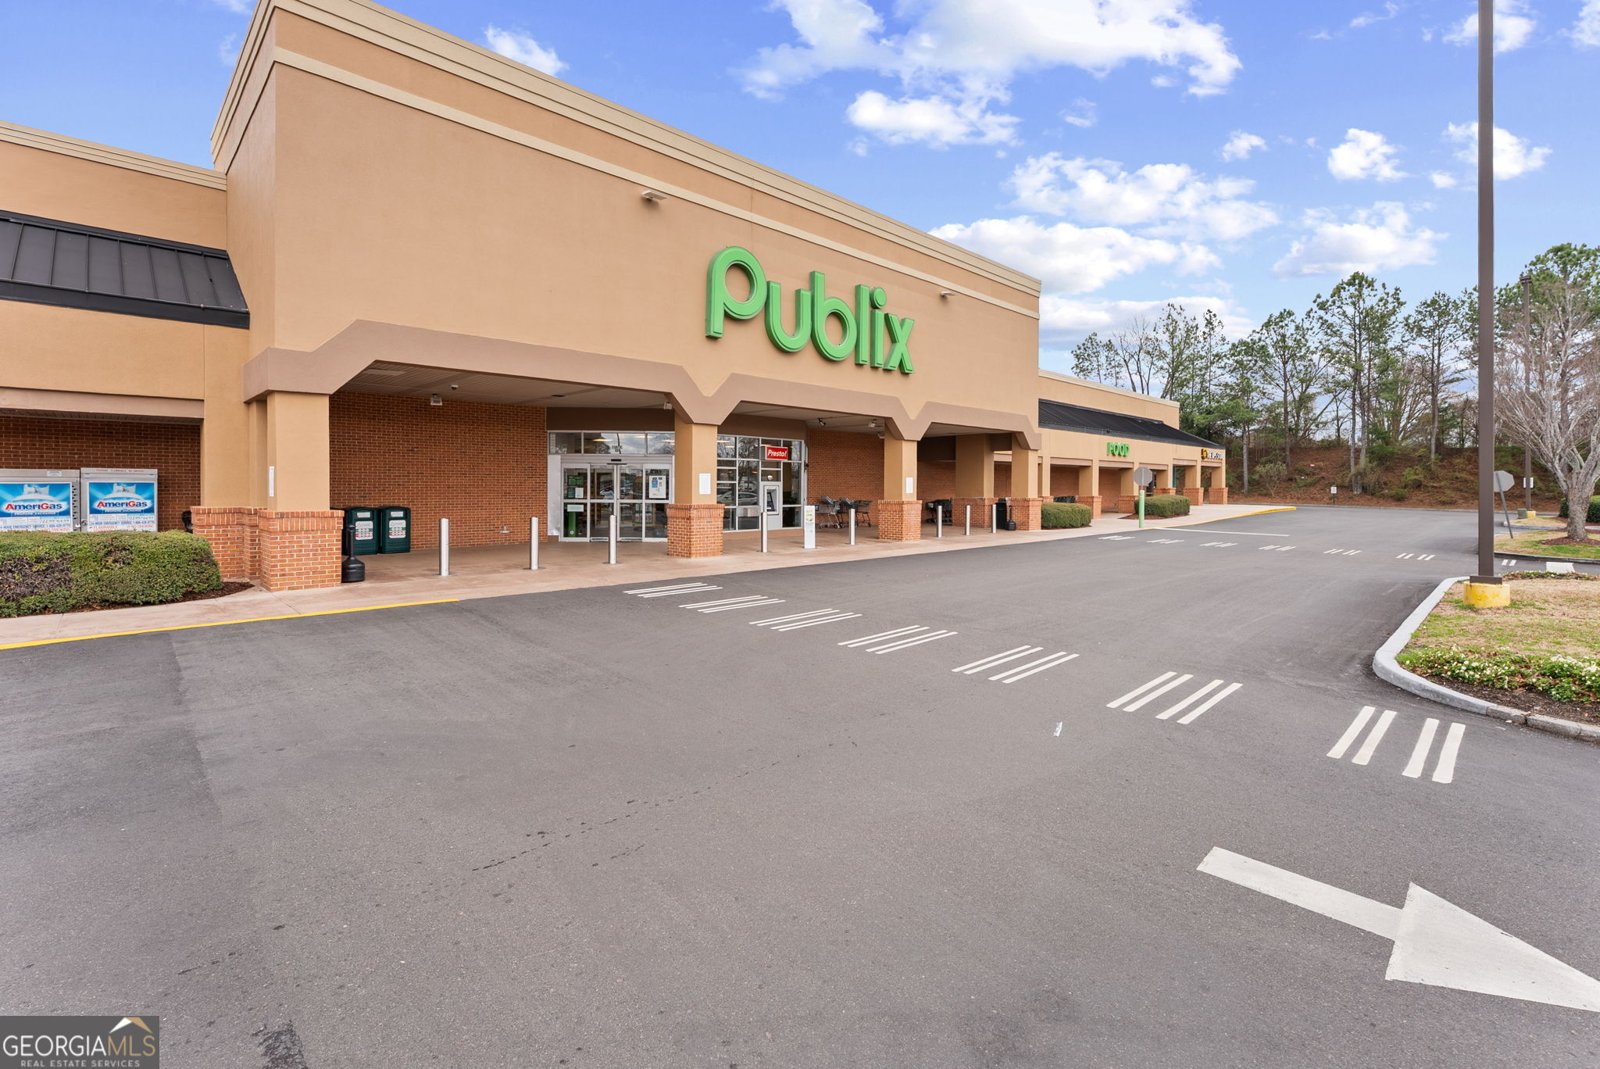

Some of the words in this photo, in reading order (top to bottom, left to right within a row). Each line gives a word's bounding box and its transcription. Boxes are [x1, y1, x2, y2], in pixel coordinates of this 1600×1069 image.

[705, 246, 915, 374] Publix
[768, 449, 787, 457] Presto!
[5, 502, 63, 511] AmeriGas
[96, 500, 148, 508] AmeriGas
